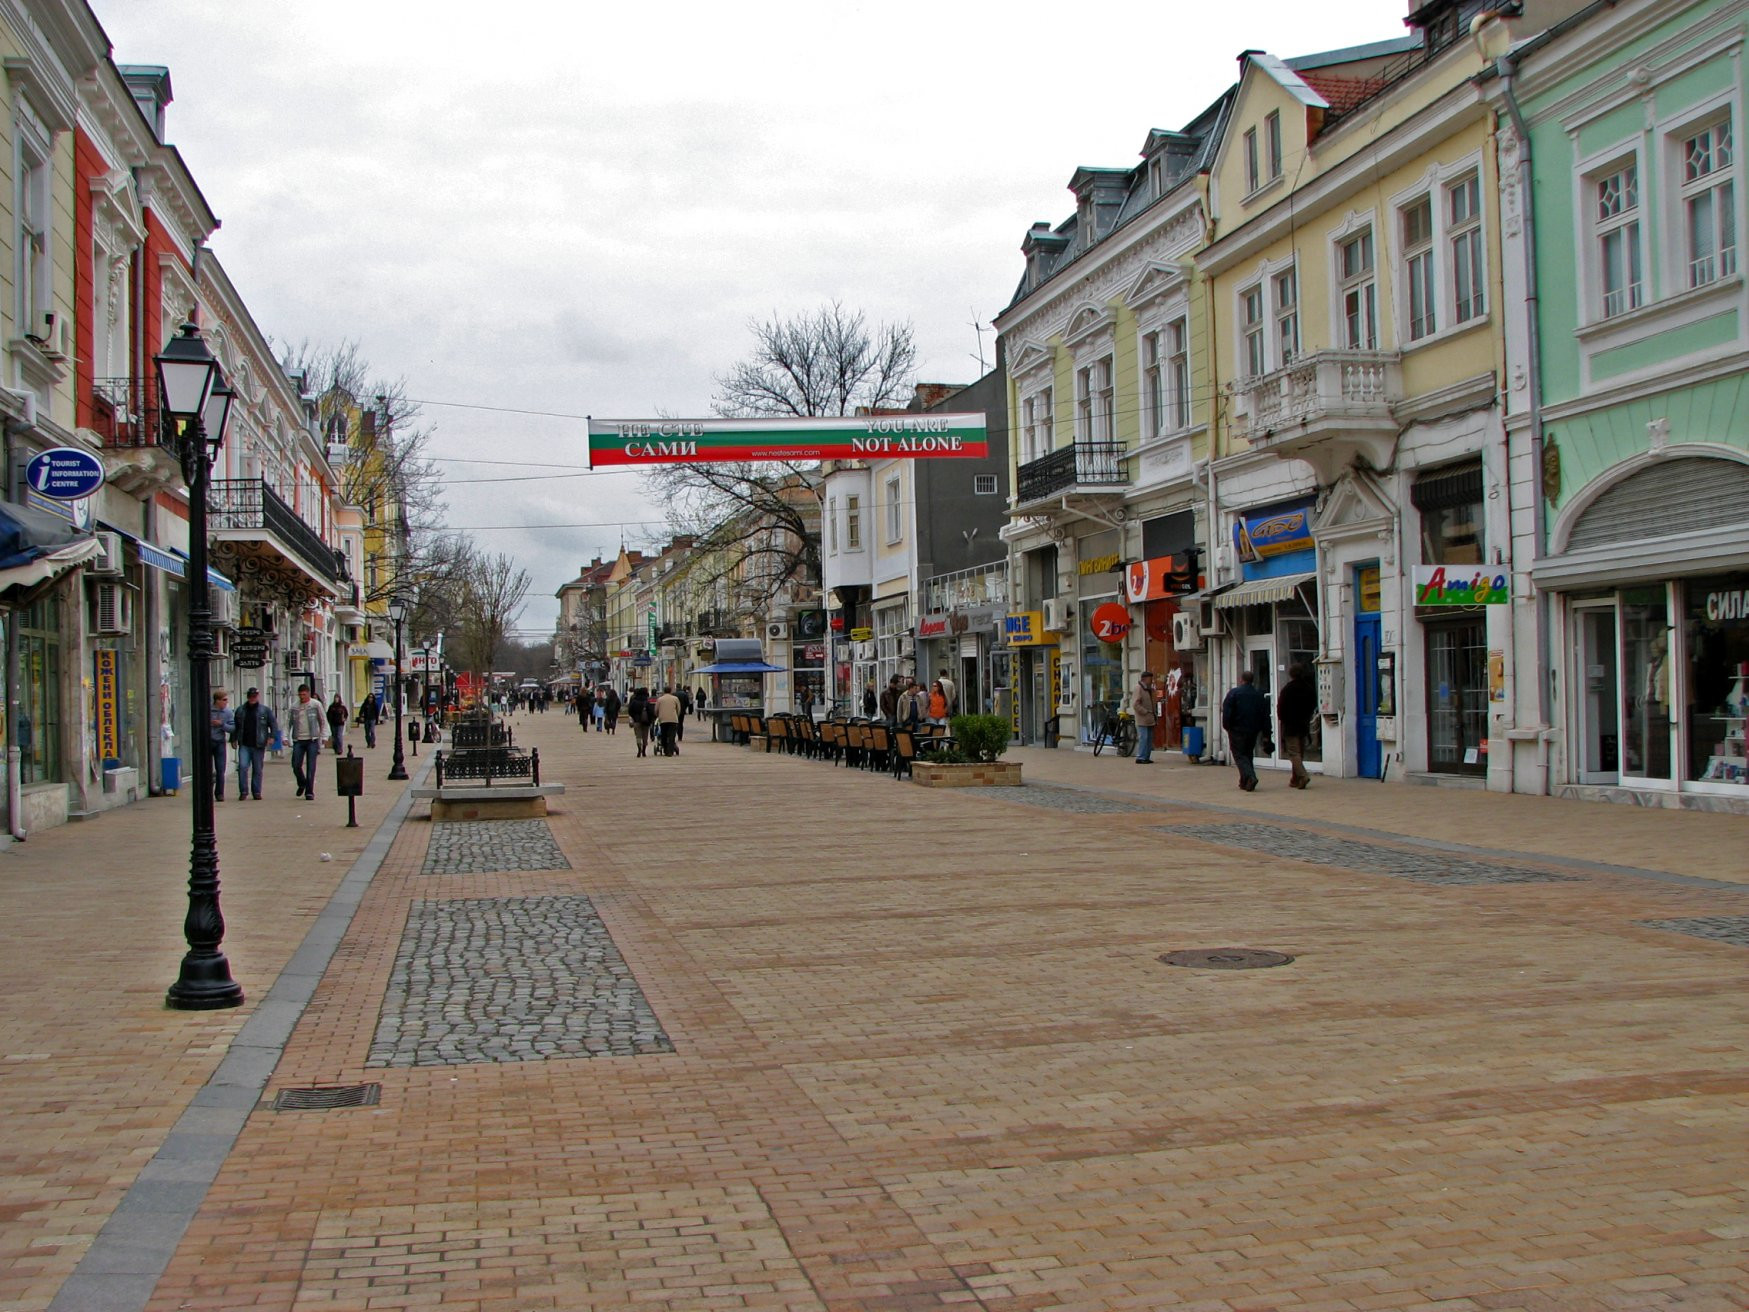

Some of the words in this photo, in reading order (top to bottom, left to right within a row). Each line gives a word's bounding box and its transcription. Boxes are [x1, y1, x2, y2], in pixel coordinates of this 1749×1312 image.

[616, 423, 651, 438] НЕ
[657, 422, 704, 437] СТЕ
[865, 420, 905, 434] YOU
[910, 418, 949, 433] ARE
[624, 441, 698, 457] САМИ
[851, 437, 892, 453] NOT
[897, 436, 963, 452] ALONE
[51, 470, 99, 478] INFORMATION
[51, 480, 79, 488] CENTRE
[1420, 566, 1505, 603] Amigo
[101, 650, 114, 699] КОЖЕНИ
[103, 702, 114, 758] ОБЛЕКЛА
